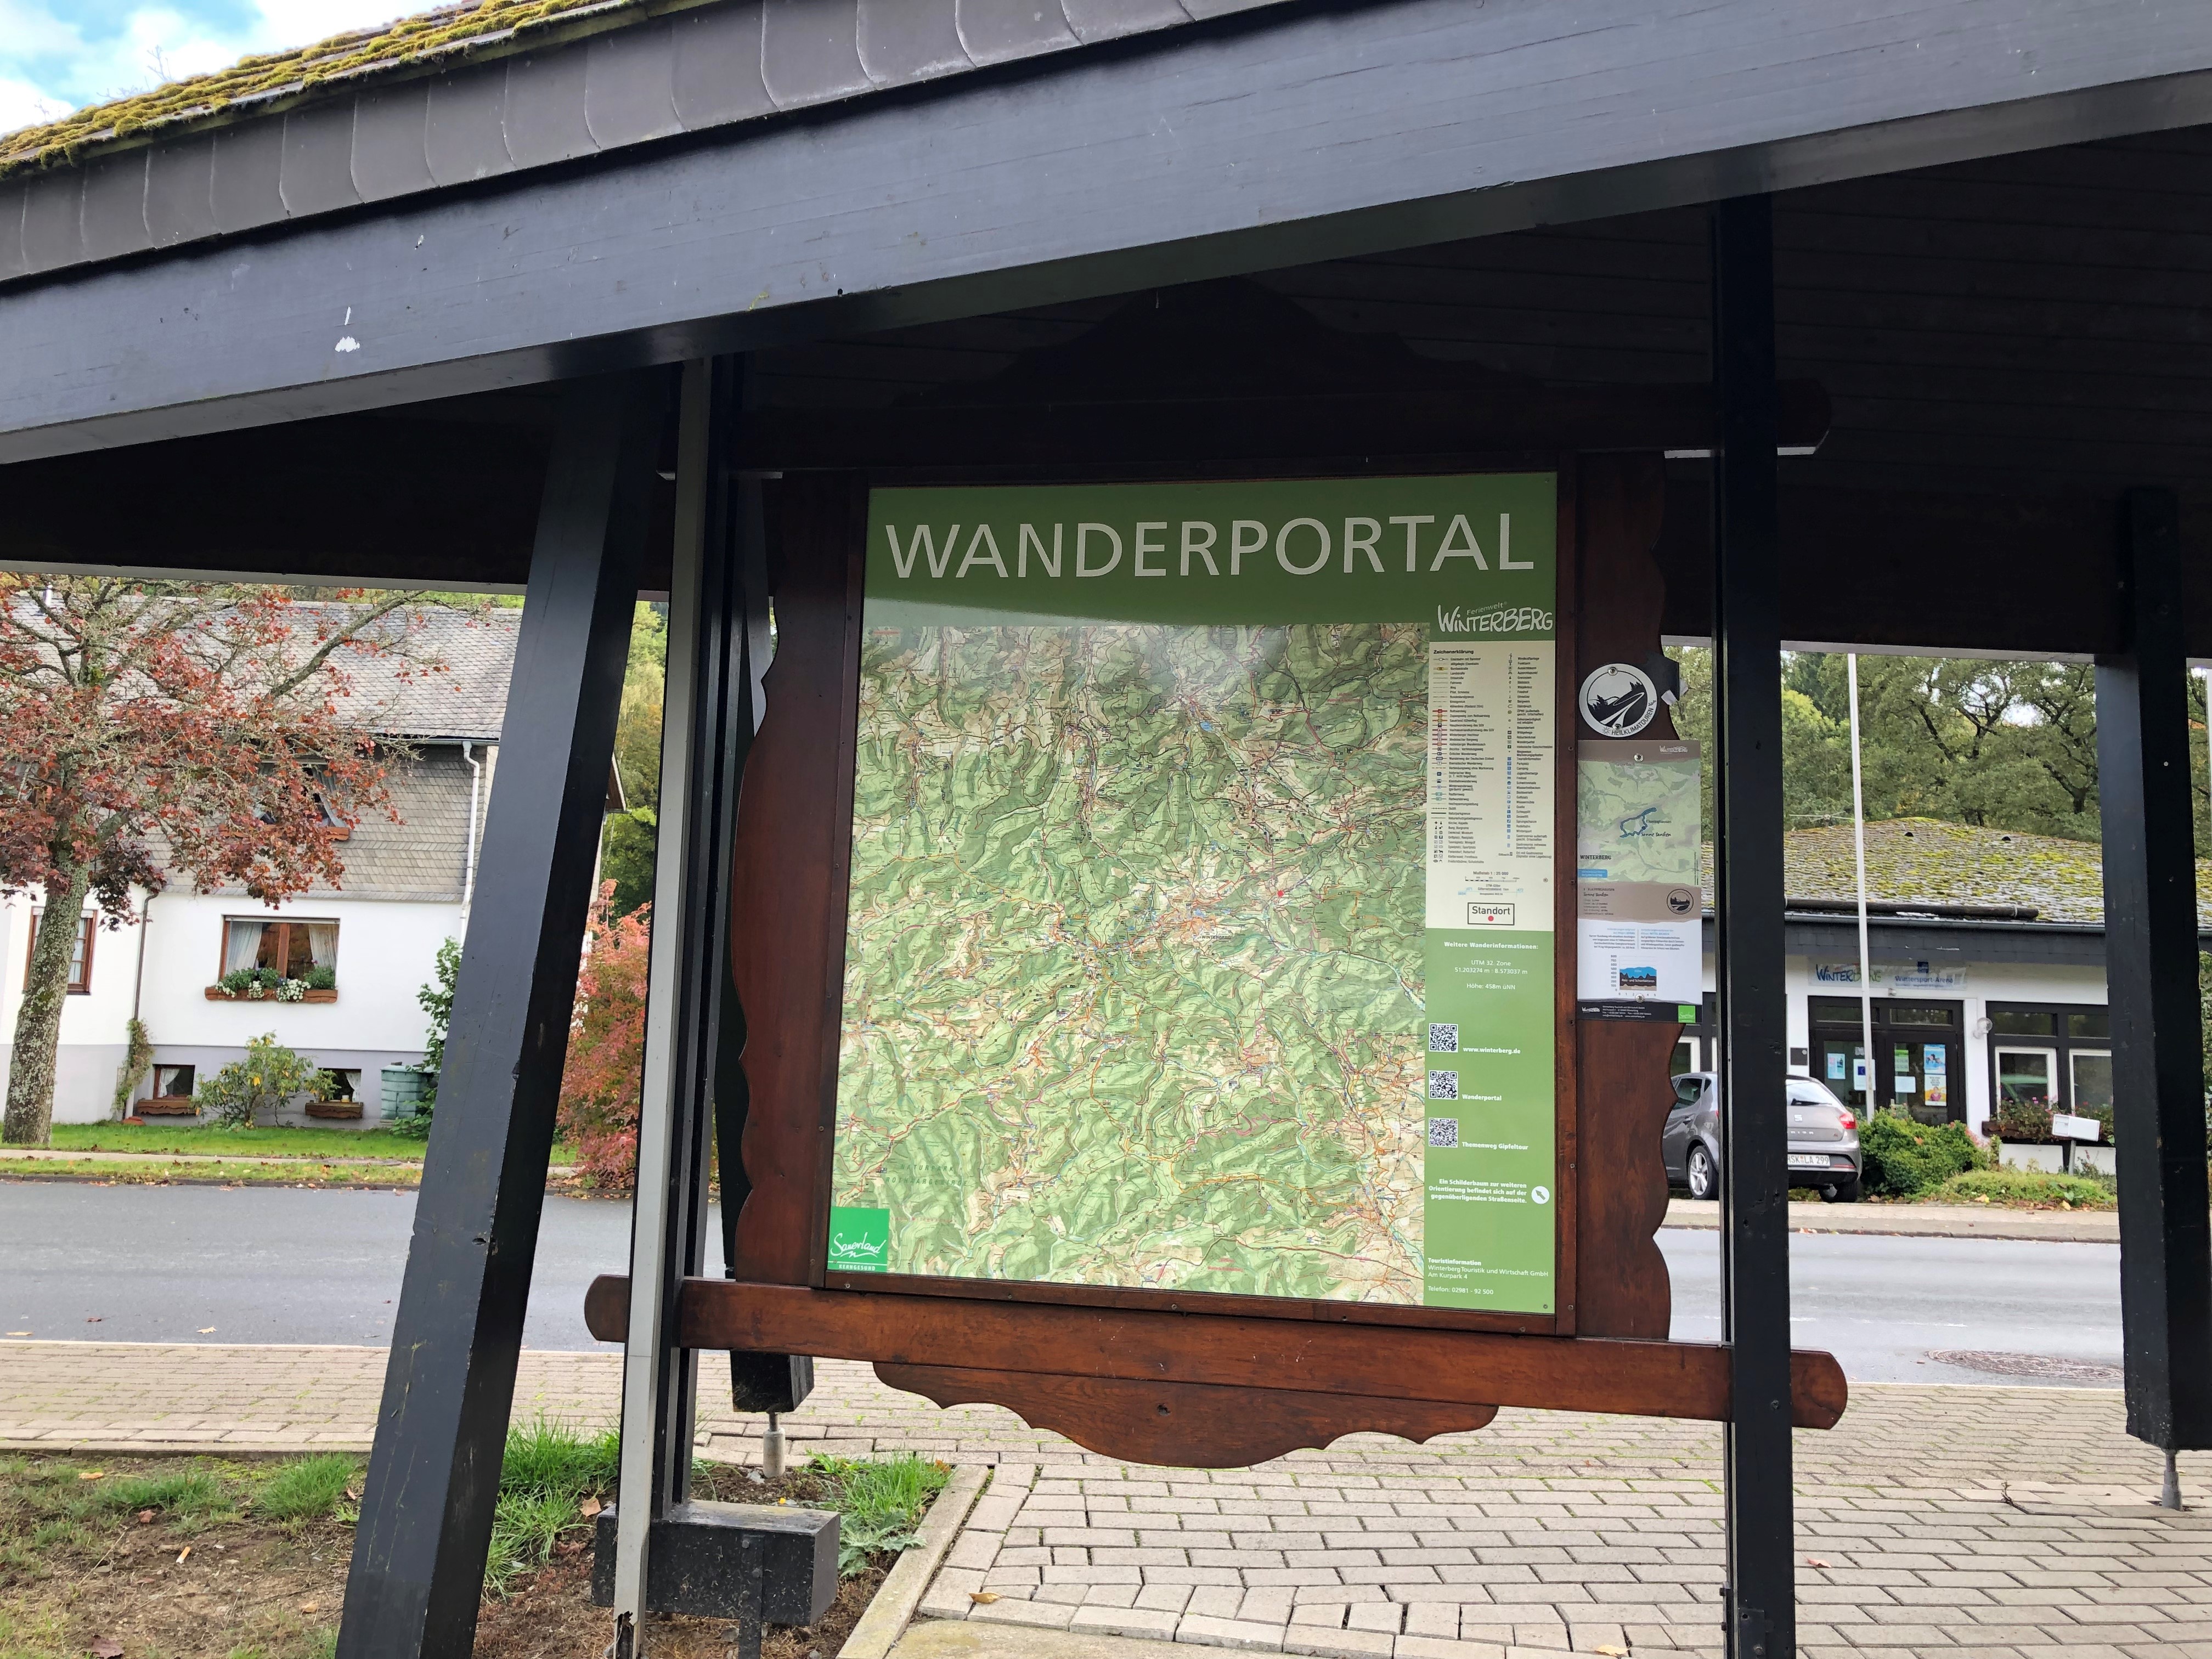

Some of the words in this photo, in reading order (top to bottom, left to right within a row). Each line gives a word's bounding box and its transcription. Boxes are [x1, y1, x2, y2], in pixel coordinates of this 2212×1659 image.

[885, 512, 1535, 578] WANDERPORTAL
[1611, 708, 1654, 736] HEILKLIMATOUREN
[1472, 906, 1510, 915] Standort
[1463, 1046, 1521, 1054] www.winterberg.de
[1462, 1142, 1497, 1150] Themenweg
[1804, 1155, 1814, 1164] LA
[1816, 1156, 1829, 1165] 299
[1429, 1186, 1466, 1194] Orientierung
[830, 1232, 887, 1256] Sauerland
[1428, 1257, 1481, 1266] Touristinformation
